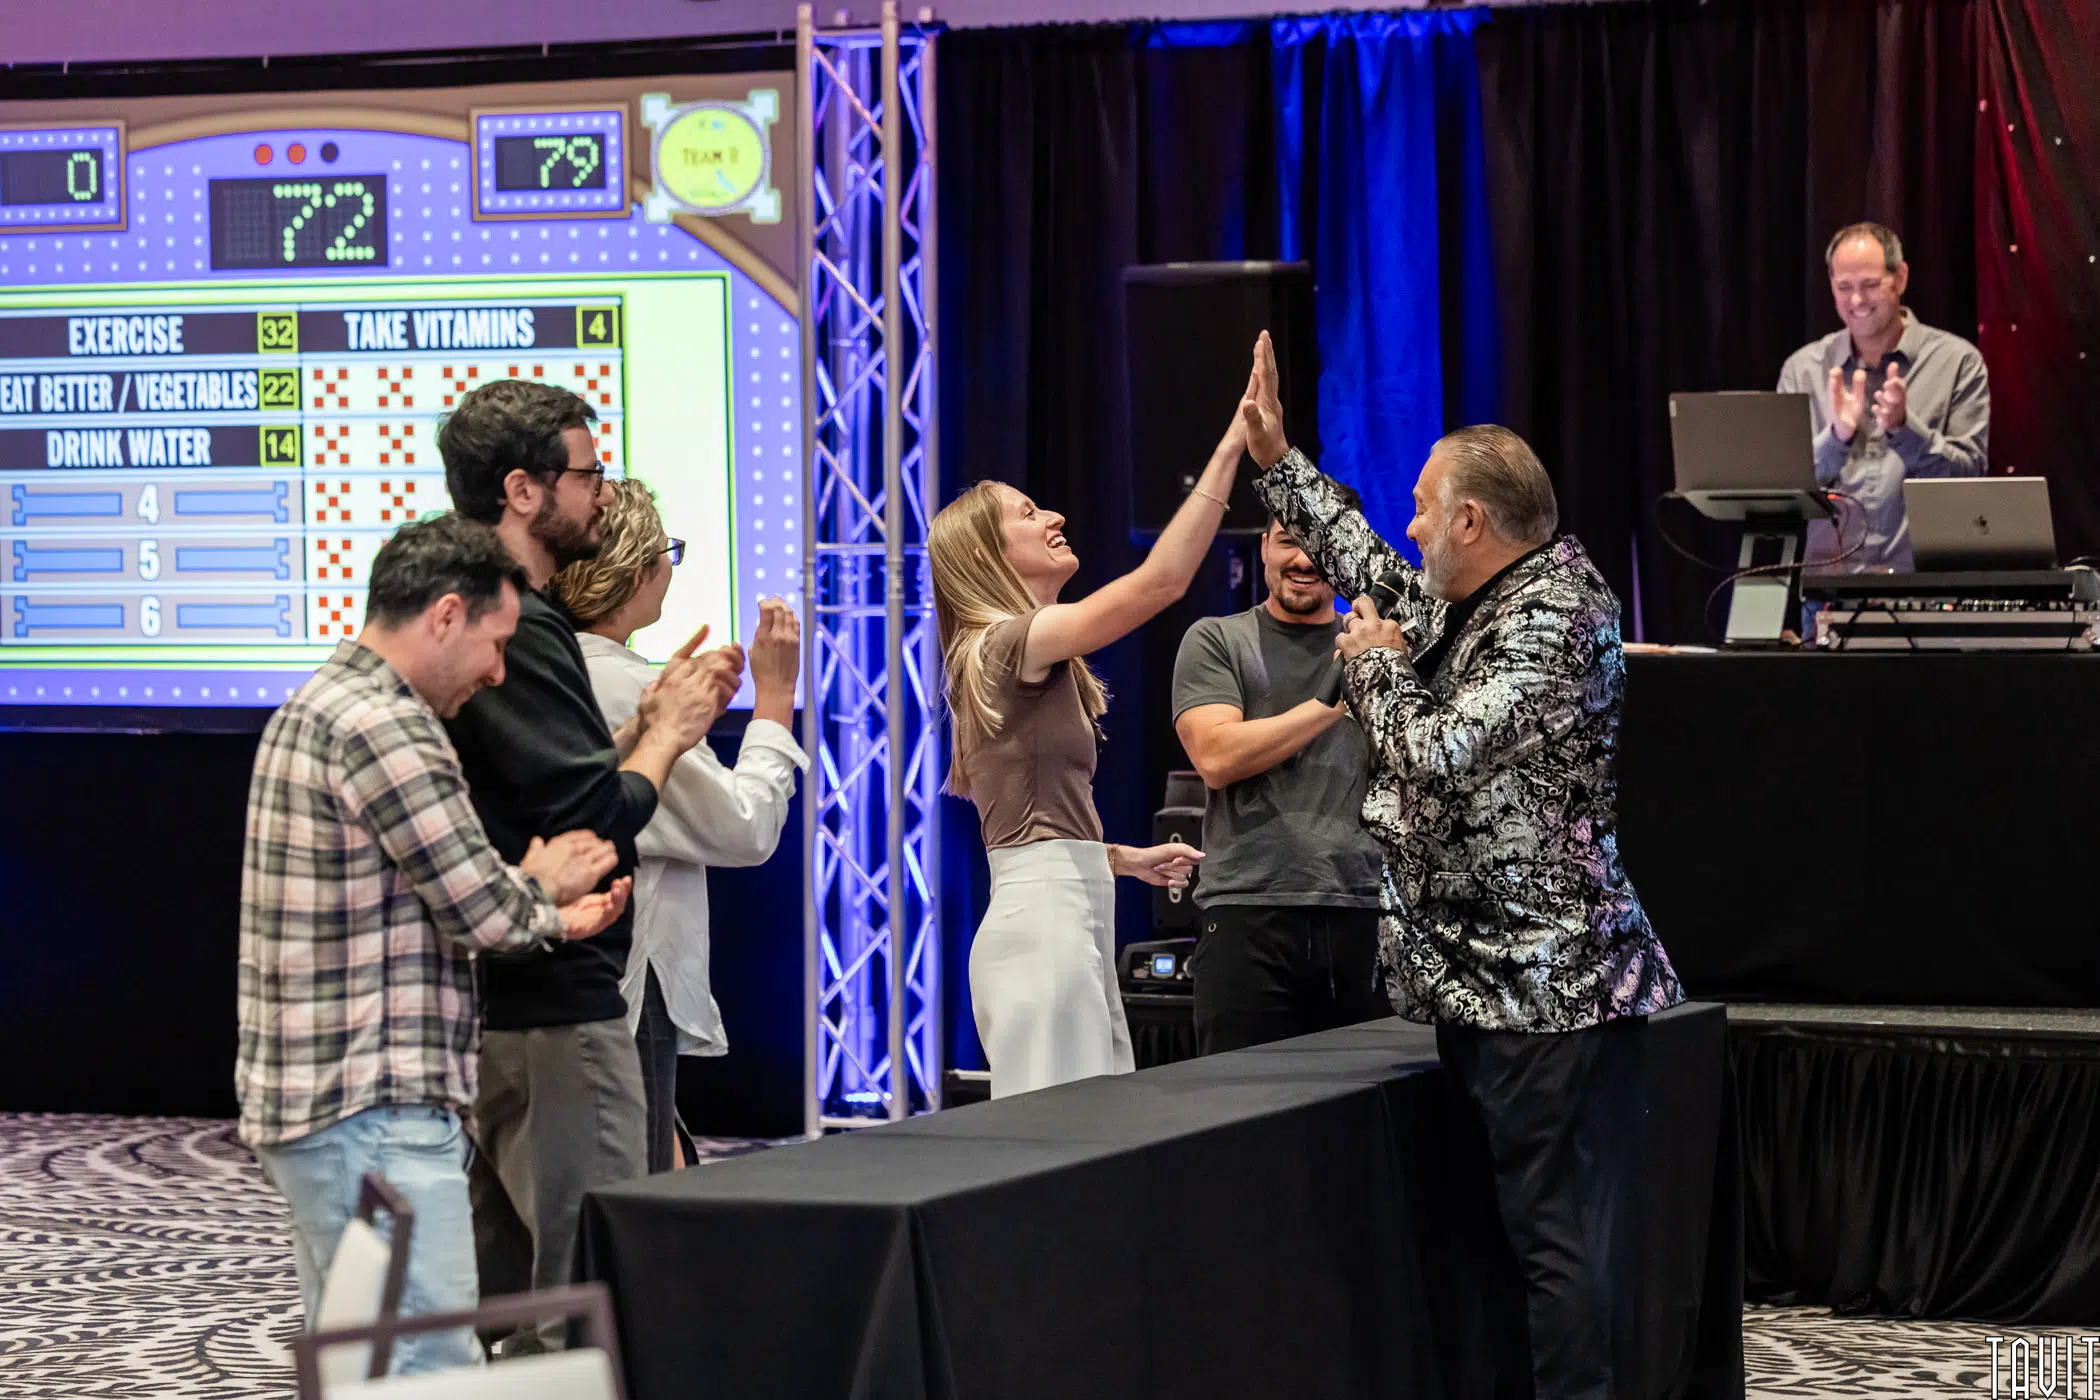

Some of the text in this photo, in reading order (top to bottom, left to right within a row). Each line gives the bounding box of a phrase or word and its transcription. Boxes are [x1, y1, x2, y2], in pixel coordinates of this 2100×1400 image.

[67, 151, 98, 200] 0
[533, 136, 599, 188] 79
[682, 147, 723, 165] TEAM
[273, 181, 376, 262] 72
[68, 315, 184, 355] EXERCISE
[262, 318, 294, 347] 32
[343, 308, 536, 350] TAKE VITAMINS
[588, 311, 608, 341] 4
[0, 374, 36, 413] EAT
[40, 373, 114, 412] BETTER
[135, 370, 258, 411] VEGETABLES
[263, 376, 295, 405] 22
[46, 428, 211, 467] DRINK WATER
[265, 431, 295, 460] 14
[137, 482, 161, 524] 4
[138, 538, 162, 581] 5
[139, 595, 162, 638] 6
